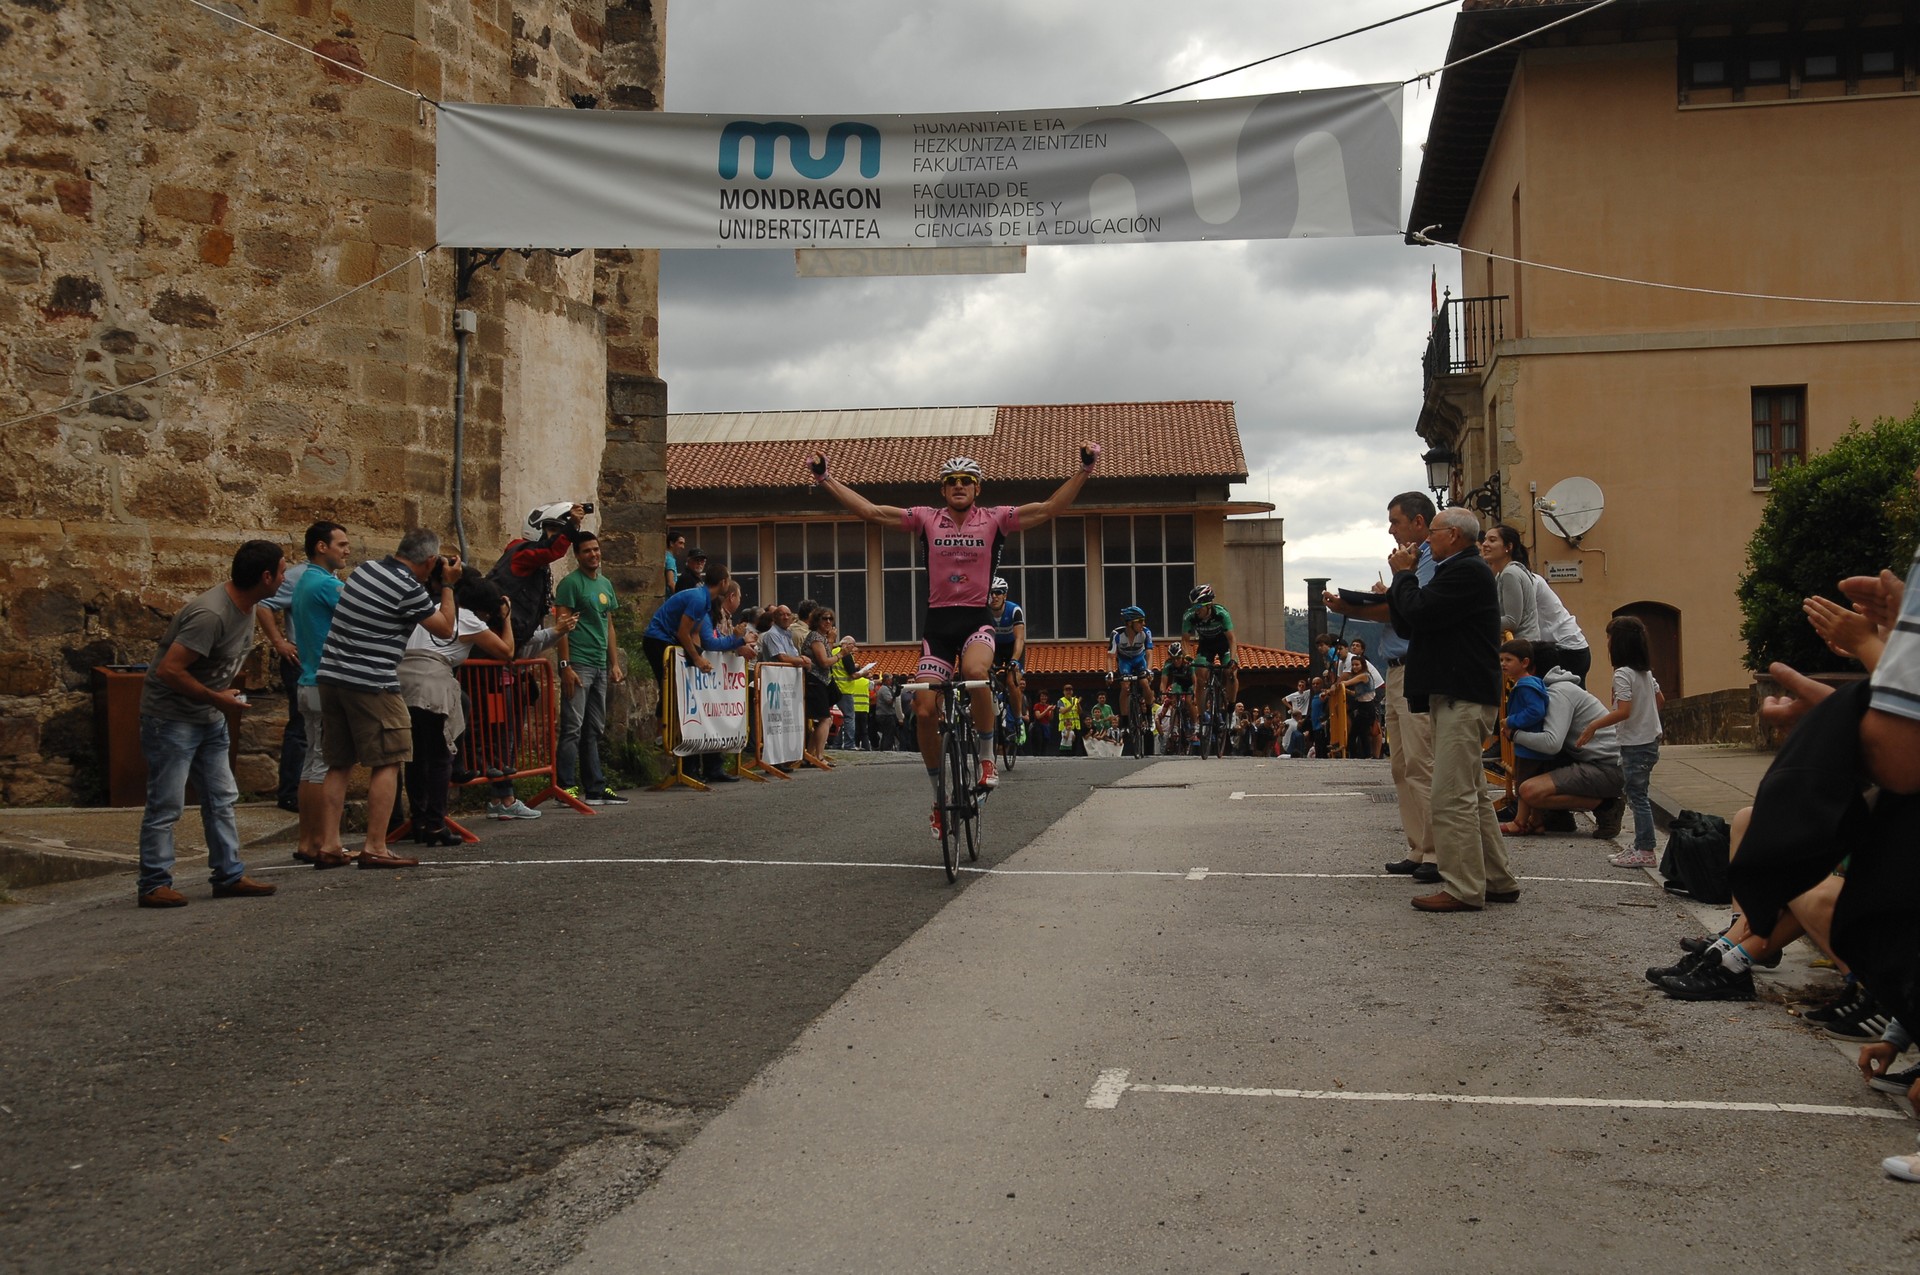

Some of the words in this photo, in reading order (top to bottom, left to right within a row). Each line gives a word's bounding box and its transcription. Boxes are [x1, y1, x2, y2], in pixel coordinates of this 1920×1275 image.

[913, 119, 1028, 135] HUMANITATE
[1034, 118, 1065, 132] ETA
[913, 136, 1017, 153] HEZKUNTZA
[1022, 134, 1107, 151] ZIENTZIEN
[913, 157, 1018, 173] FAKULTATEA
[913, 183, 1000, 198] FACULTAD
[1006, 182, 1029, 198] DE
[720, 188, 881, 211] MONDRAGON
[913, 202, 1044, 219] HUMANIDADES
[1050, 202, 1062, 216] Y
[719, 218, 881, 239] UNIBERTSITATEA
[914, 222, 993, 238] CIENCIAS
[999, 222, 1021, 236] DE
[1027, 221, 1048, 236] LA
[1054, 214, 1162, 236] EDUCACIÓN
[934, 539, 985, 547] GOMUR
